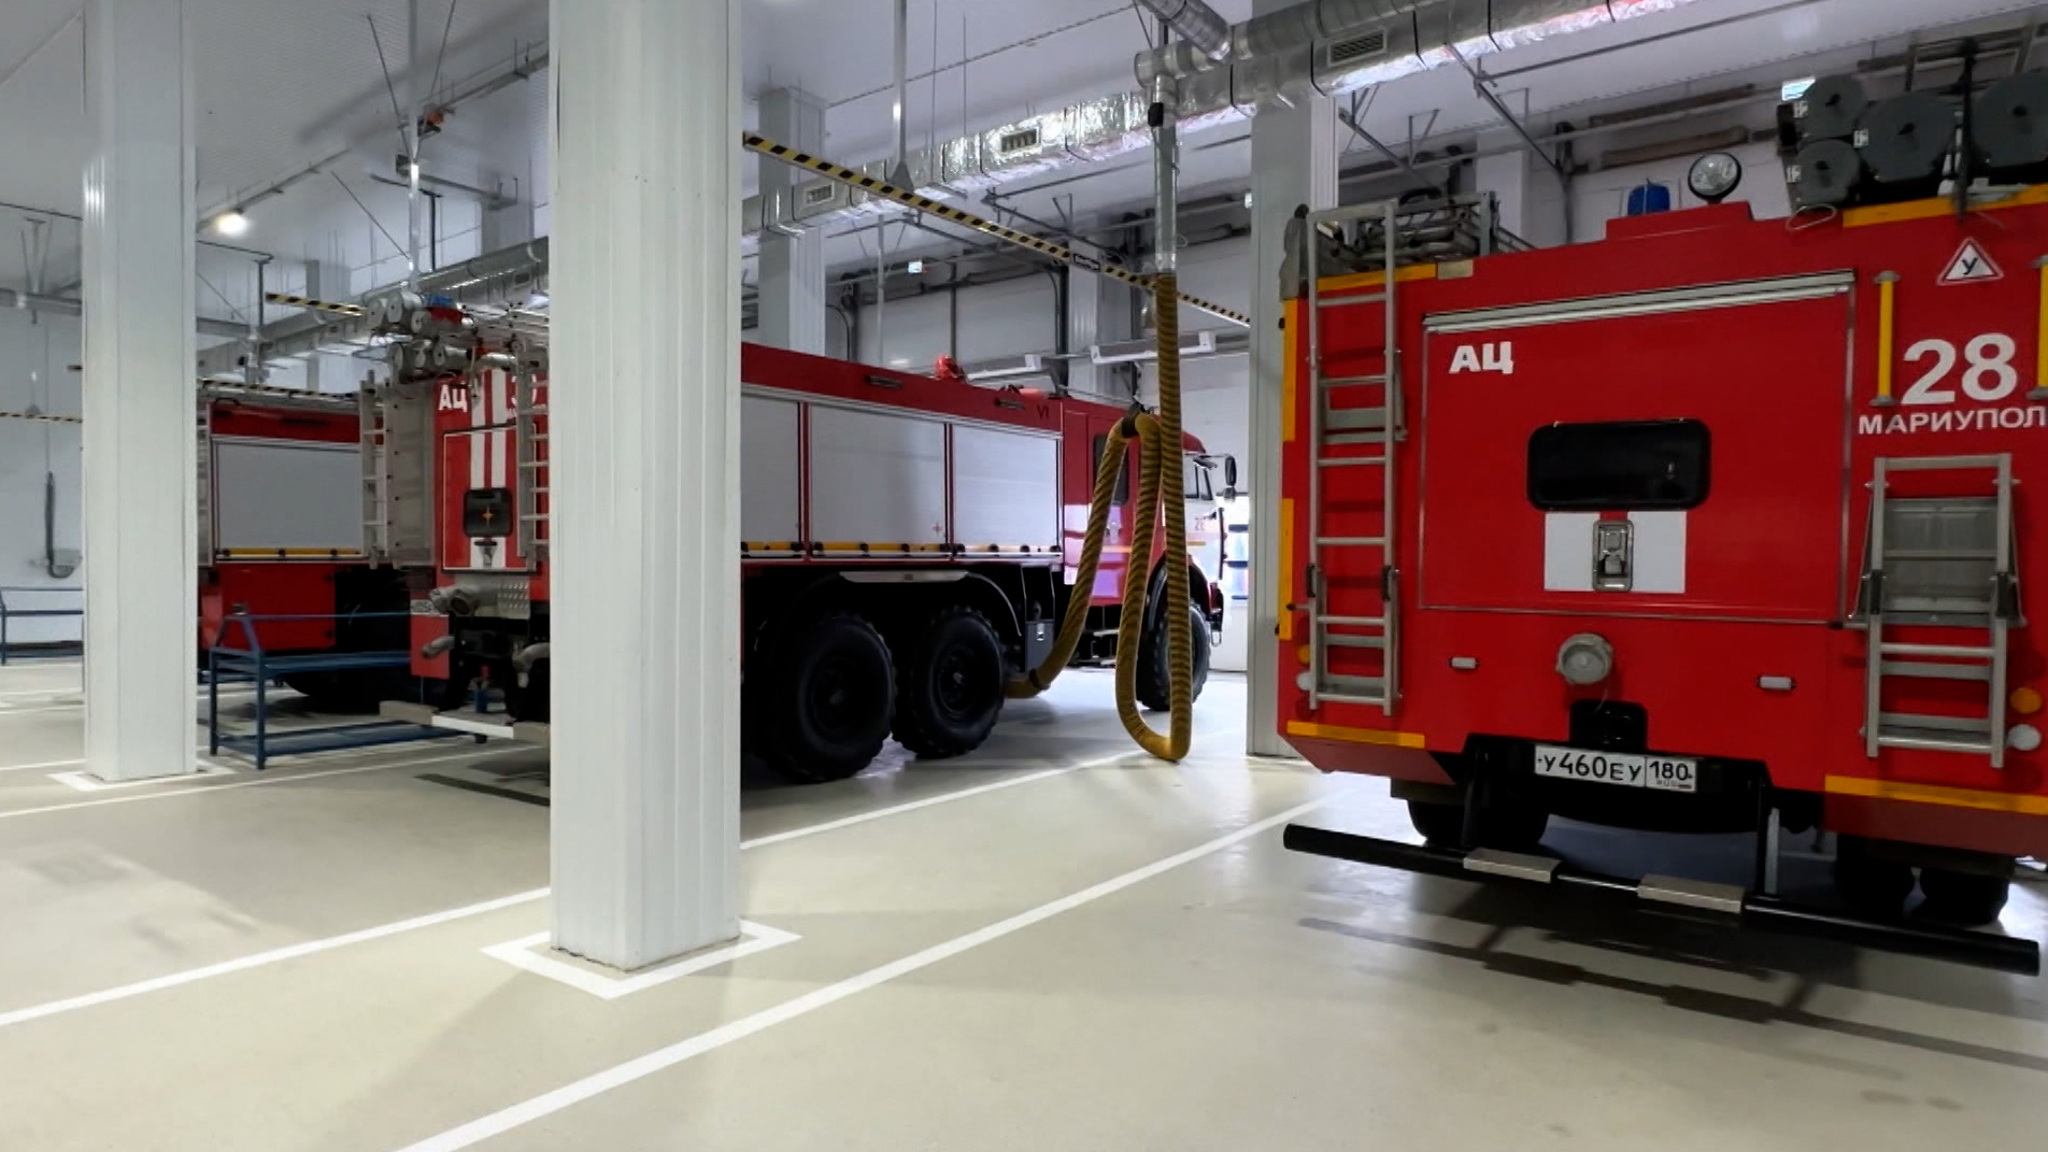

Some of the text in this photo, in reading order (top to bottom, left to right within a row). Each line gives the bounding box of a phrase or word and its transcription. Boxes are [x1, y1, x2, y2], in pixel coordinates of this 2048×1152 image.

[1961, 256, 1979, 275] У
[1448, 341, 1514, 375] АЦ
[1901, 332, 2018, 405] 28
[438, 382, 468, 412] АЦ
[1858, 405, 2046, 435] МАРИУПОЛ
[1649, 760, 1689, 781] 180
